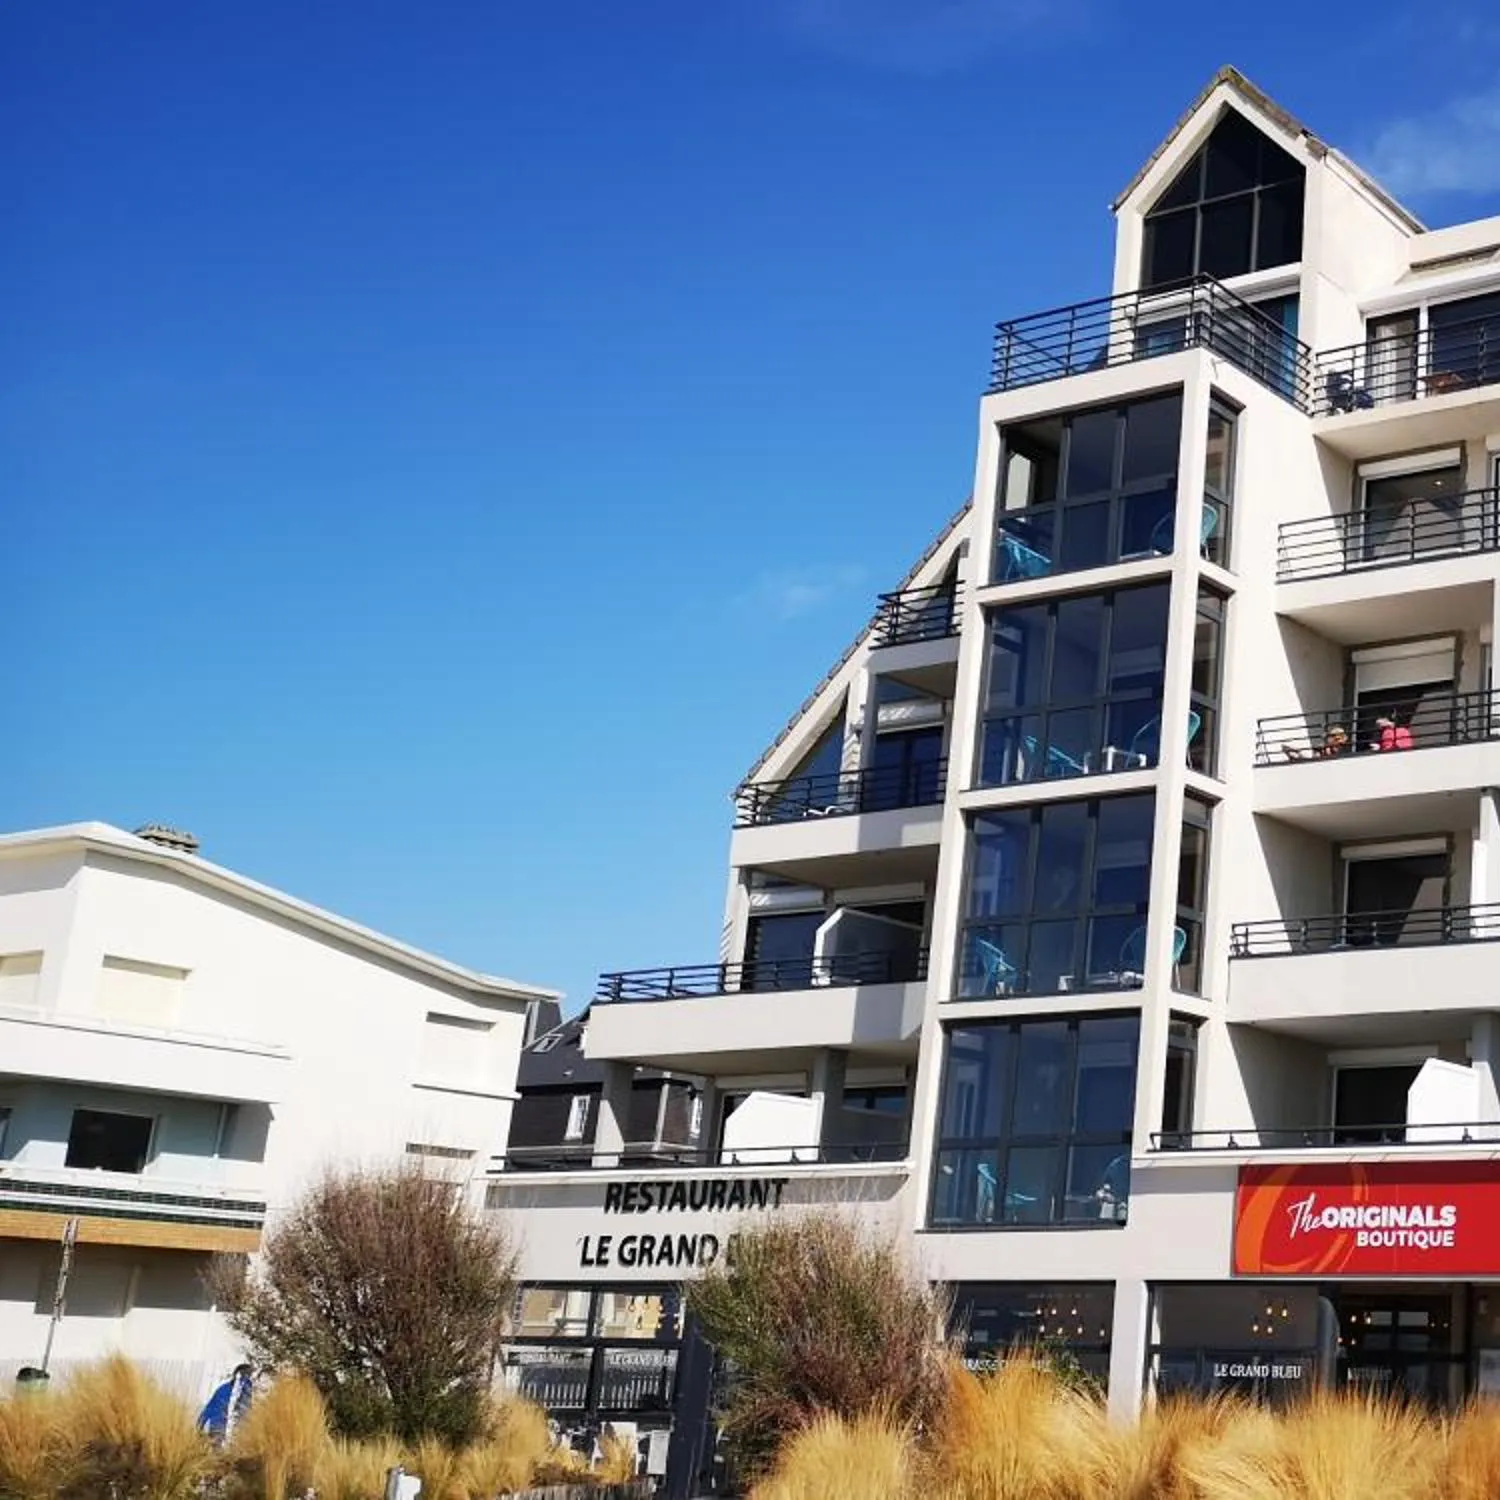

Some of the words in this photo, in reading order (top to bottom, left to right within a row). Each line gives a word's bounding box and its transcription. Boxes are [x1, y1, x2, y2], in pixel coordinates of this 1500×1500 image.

[602, 1178, 789, 1214] RESTAURANT
[580, 1235, 613, 1267] LE
[617, 1233, 720, 1267] GRAND
[1357, 1230, 1455, 1251] BOUTIQUE
[1214, 1363, 1227, 1377] LE
[1229, 1364, 1269, 1378] GRAND
[1272, 1365, 1301, 1379] BLEU
